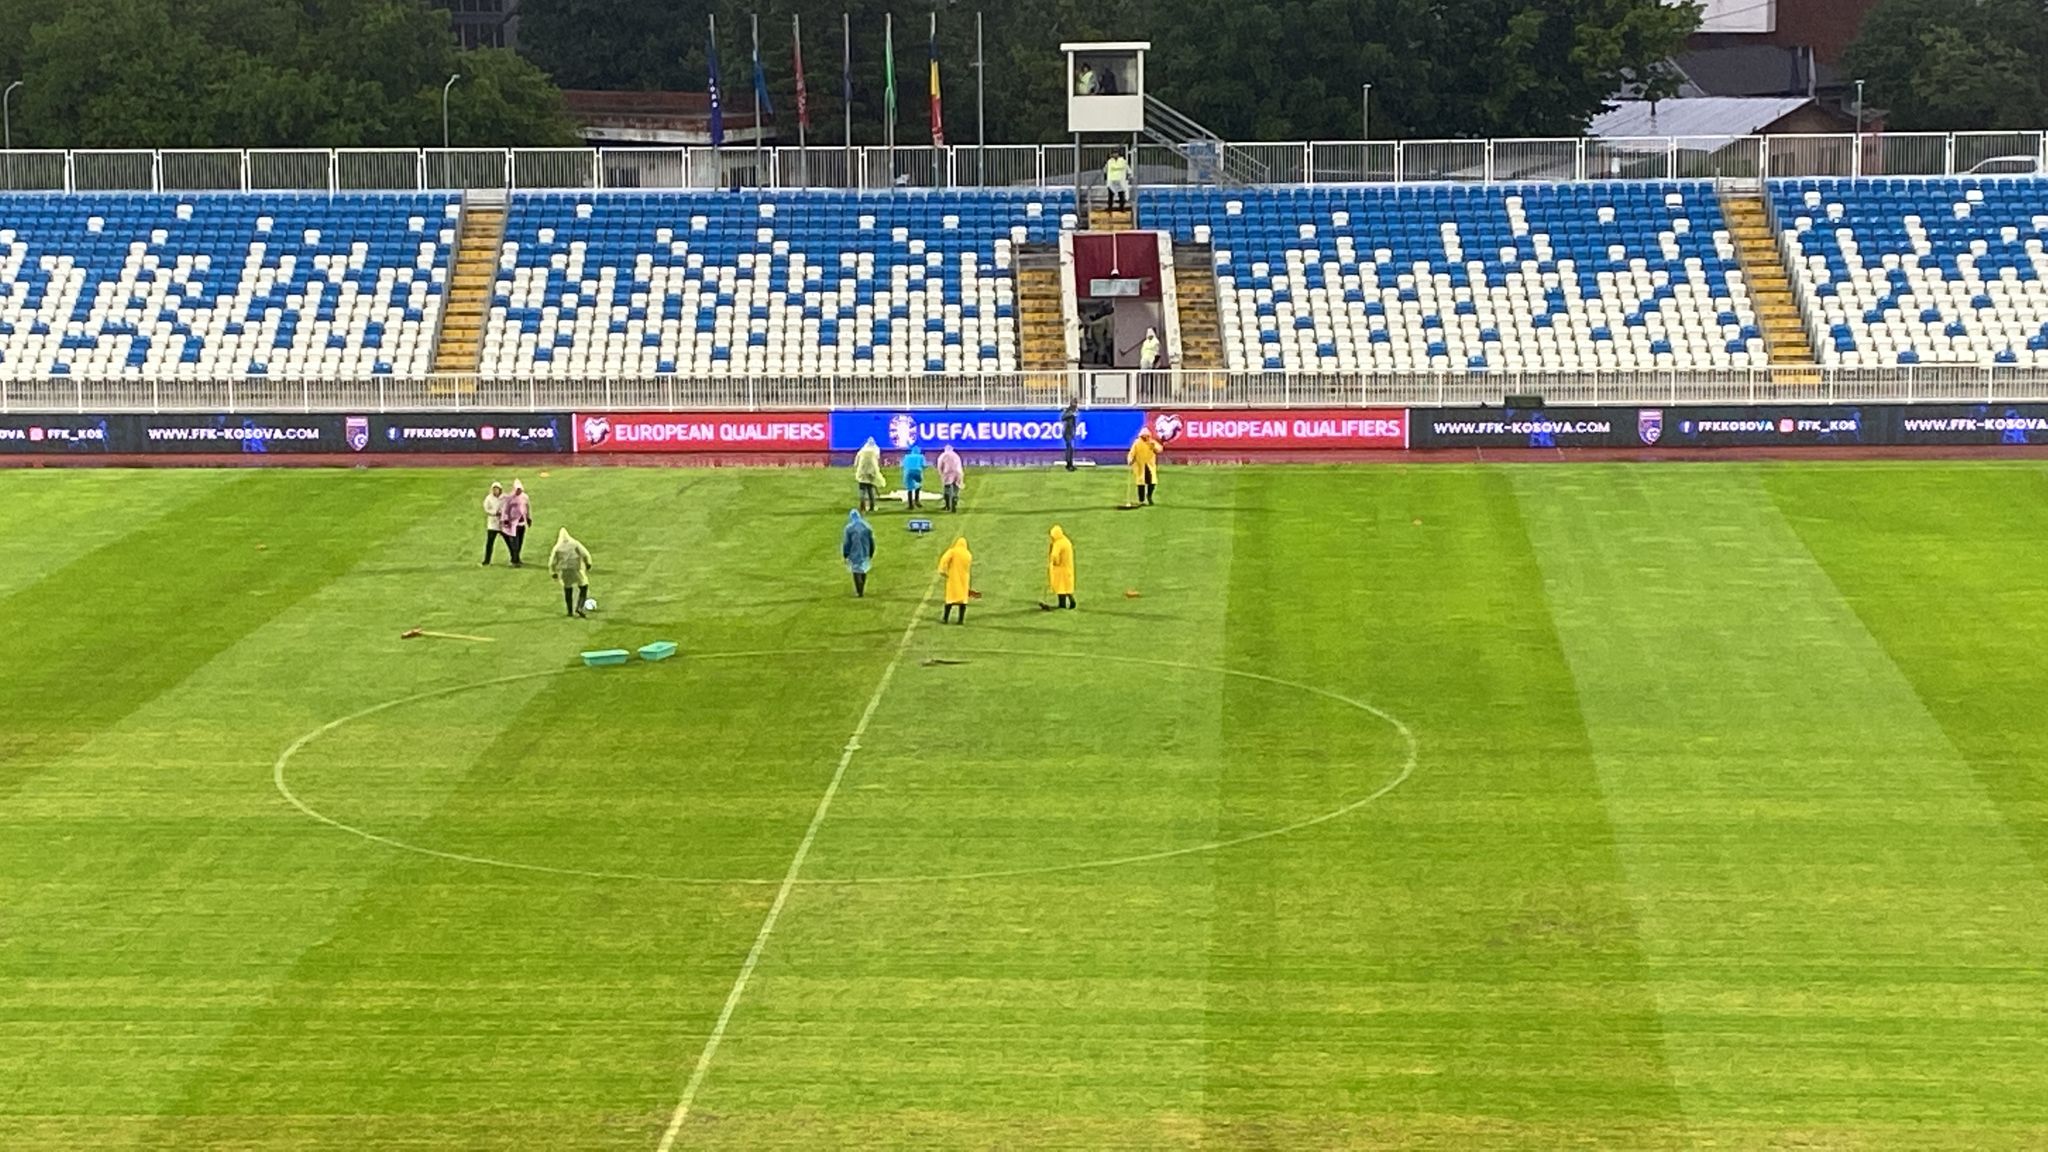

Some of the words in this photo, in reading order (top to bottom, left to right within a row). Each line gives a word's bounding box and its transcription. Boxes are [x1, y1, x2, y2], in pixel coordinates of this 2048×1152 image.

[615, 424, 714, 442] EUROPEAN
[720, 424, 826, 442] QUALIFIERS
[1186, 421, 1287, 438] EUROPEAN
[1293, 419, 1401, 437] QUALIFIERS
[1433, 422, 1611, 434] WWW.FFK-KOSOVA.COM
[1698, 421, 1775, 432] FFKKOSOVA
[1798, 420, 1857, 433] FFK_KOS
[47, 429, 104, 441] FFK_KOS
[148, 428, 320, 441] WWW.FFK-KOSOVA.COM
[403, 428, 477, 439] FFKKOSOVA
[498, 427, 554, 440] FFK_KOS
